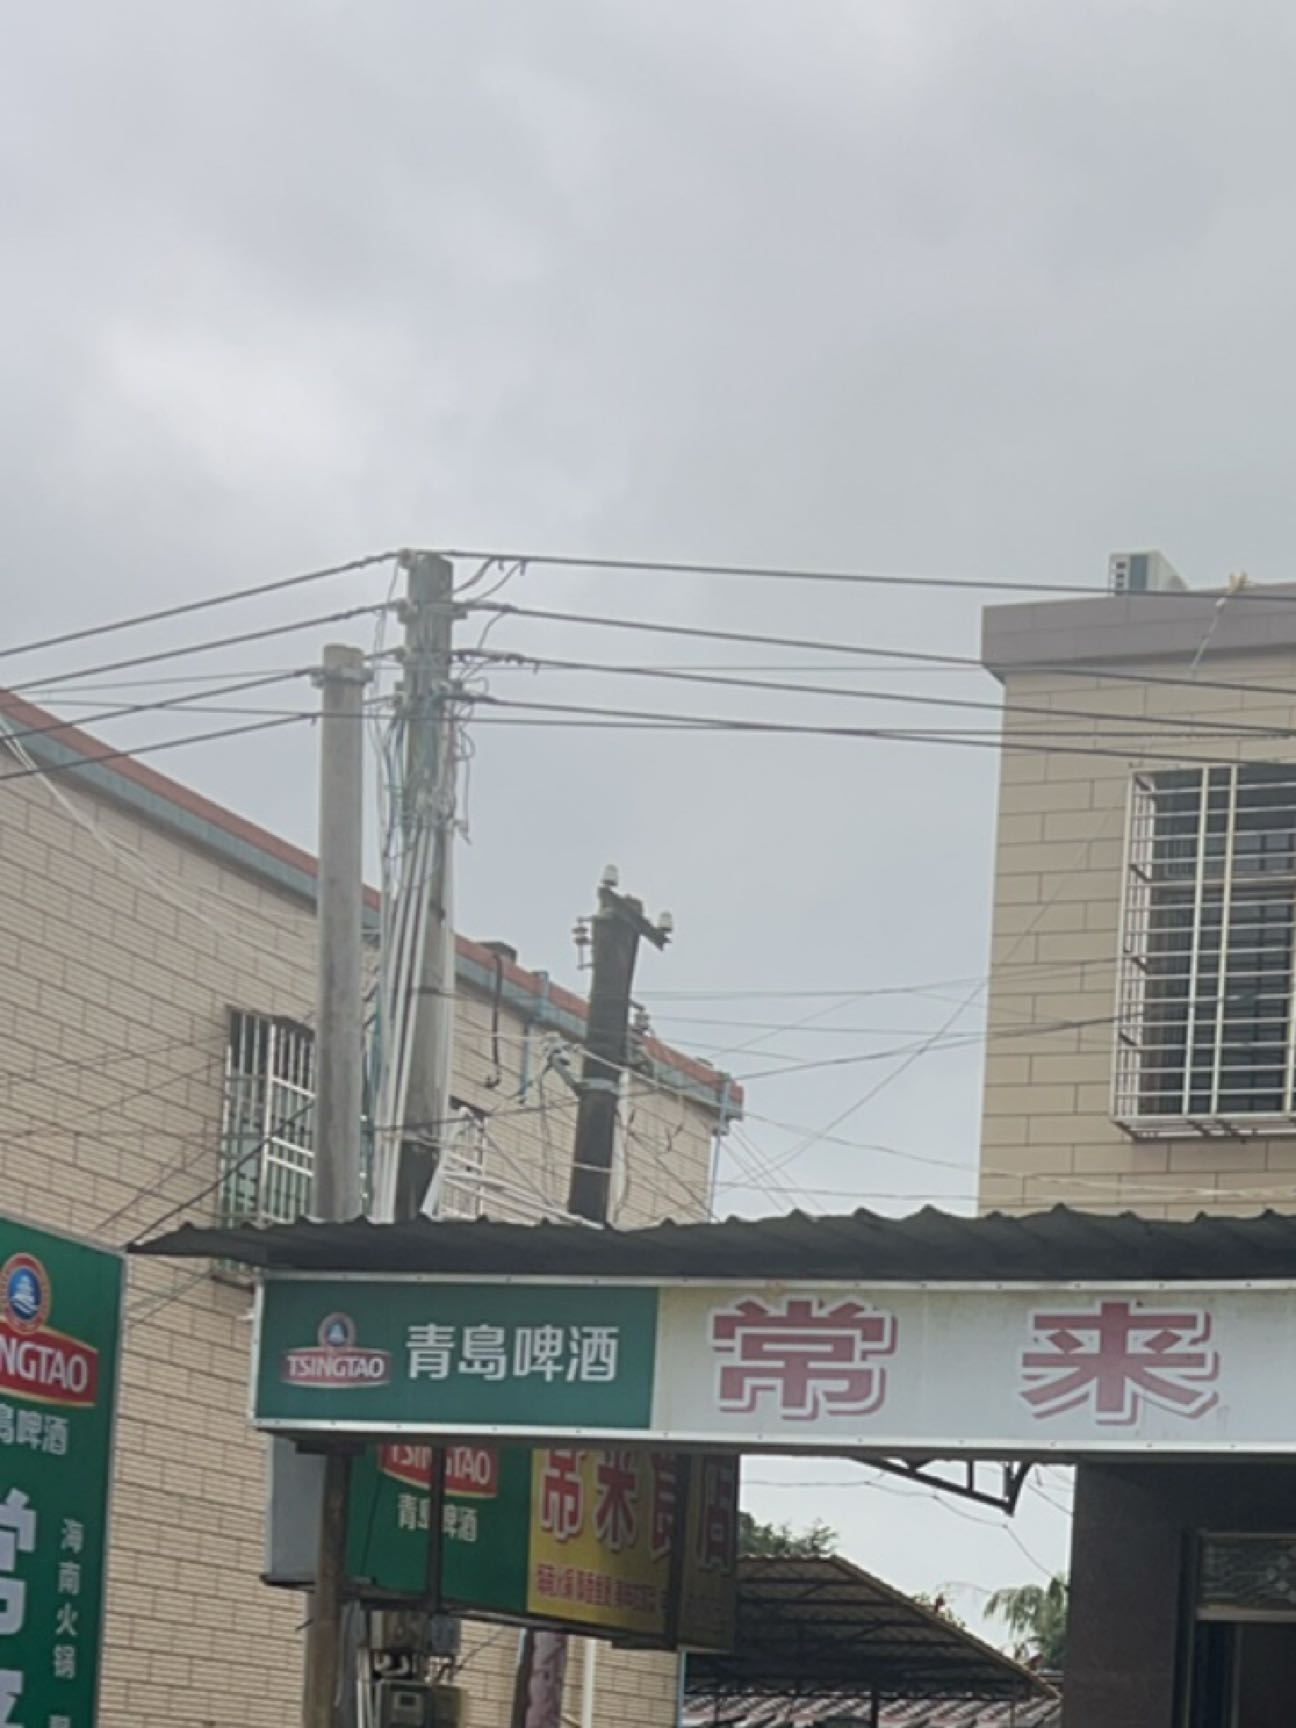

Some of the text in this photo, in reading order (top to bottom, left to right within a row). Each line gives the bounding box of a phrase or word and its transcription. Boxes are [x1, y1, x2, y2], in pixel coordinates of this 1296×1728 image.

[285, 1353, 386, 1379] TSINGTAO
[53, 1517, 85, 1680] 海南火锅
